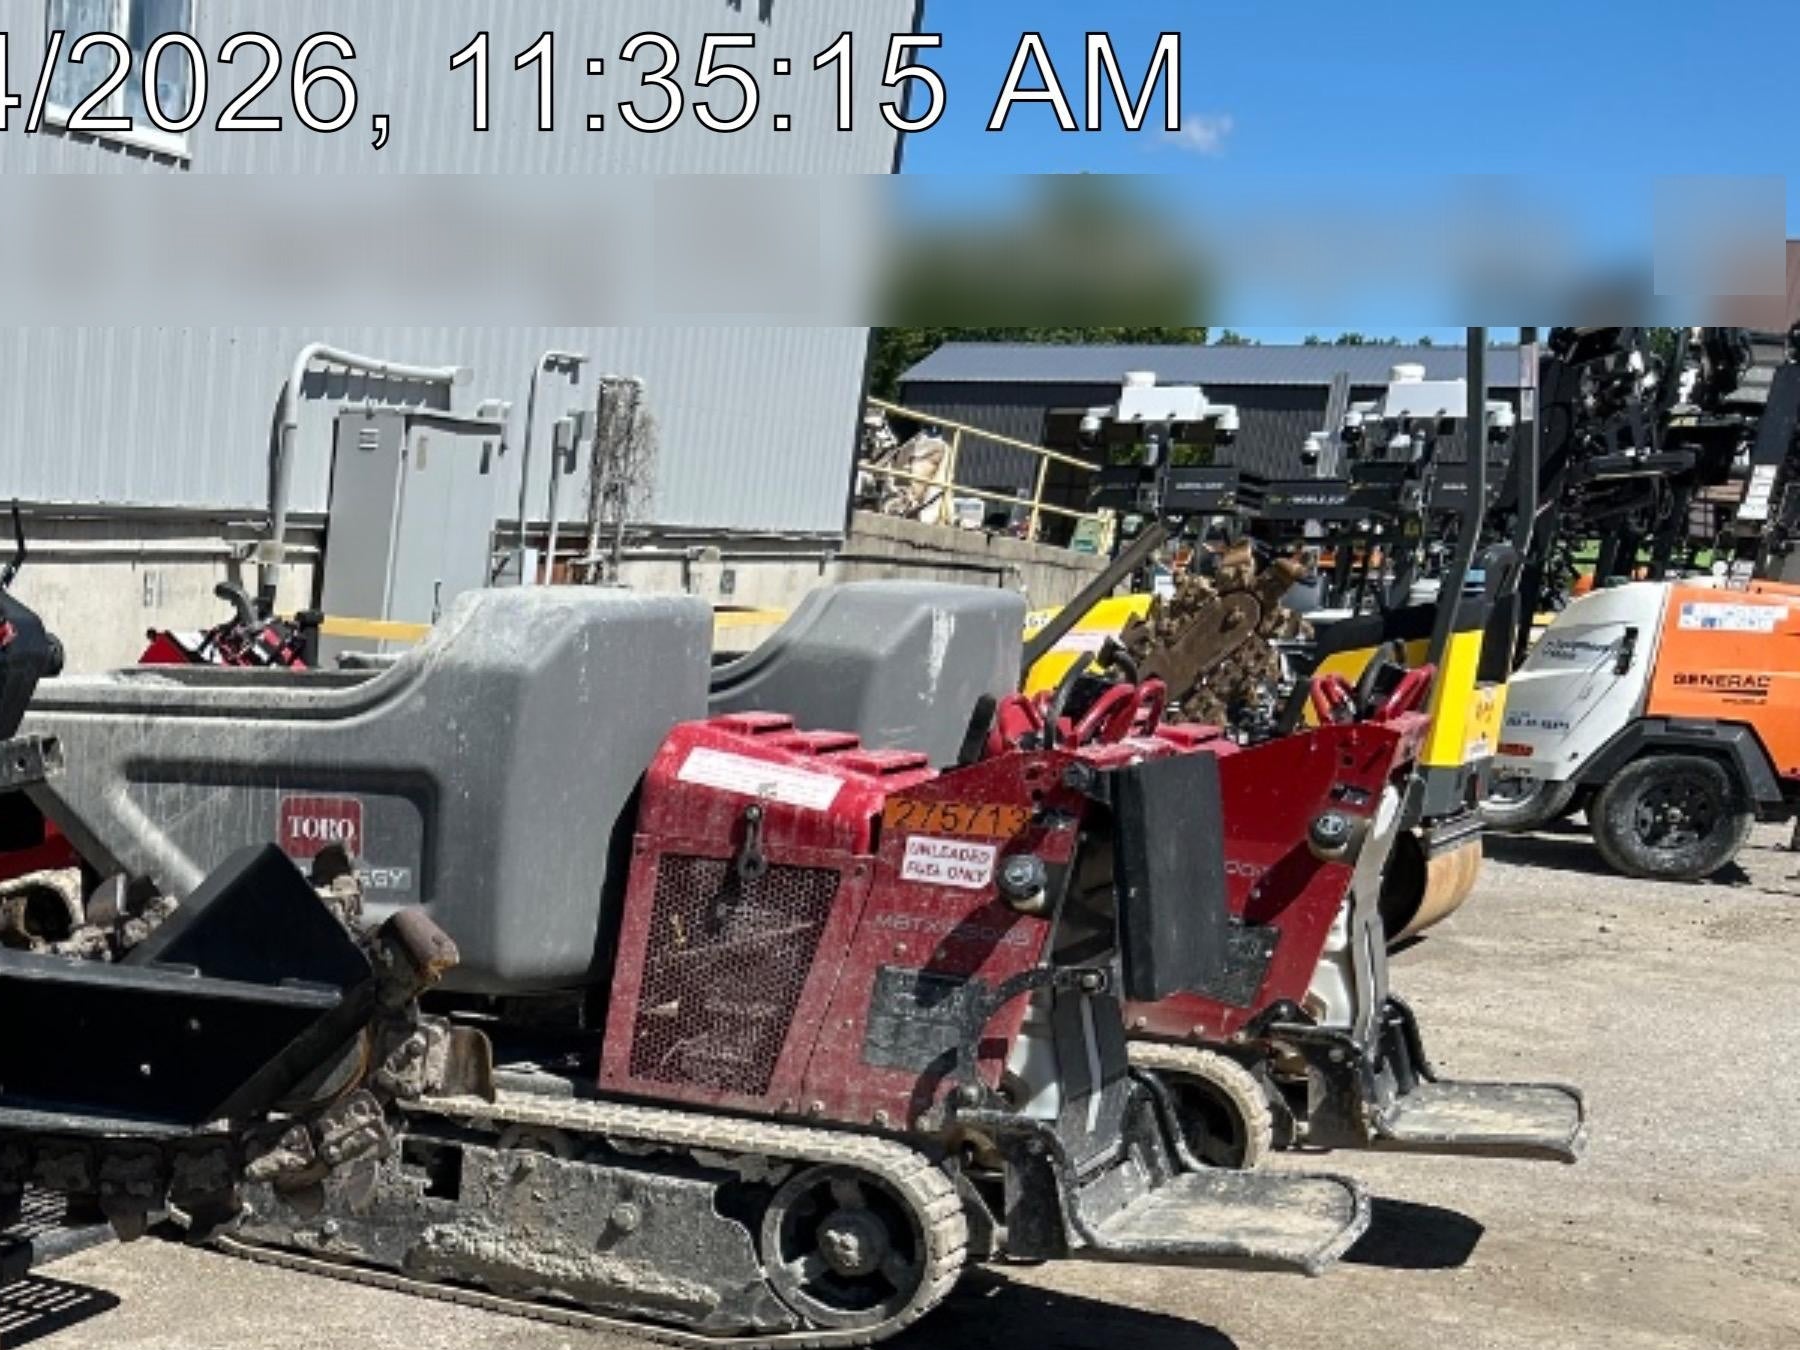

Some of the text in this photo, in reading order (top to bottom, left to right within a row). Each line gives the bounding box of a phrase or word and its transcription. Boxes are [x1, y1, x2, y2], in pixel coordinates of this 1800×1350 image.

[1673, 673, 1771, 688] GENERAC
[287, 815, 356, 840] TORO
[892, 800, 1028, 836] 275713
